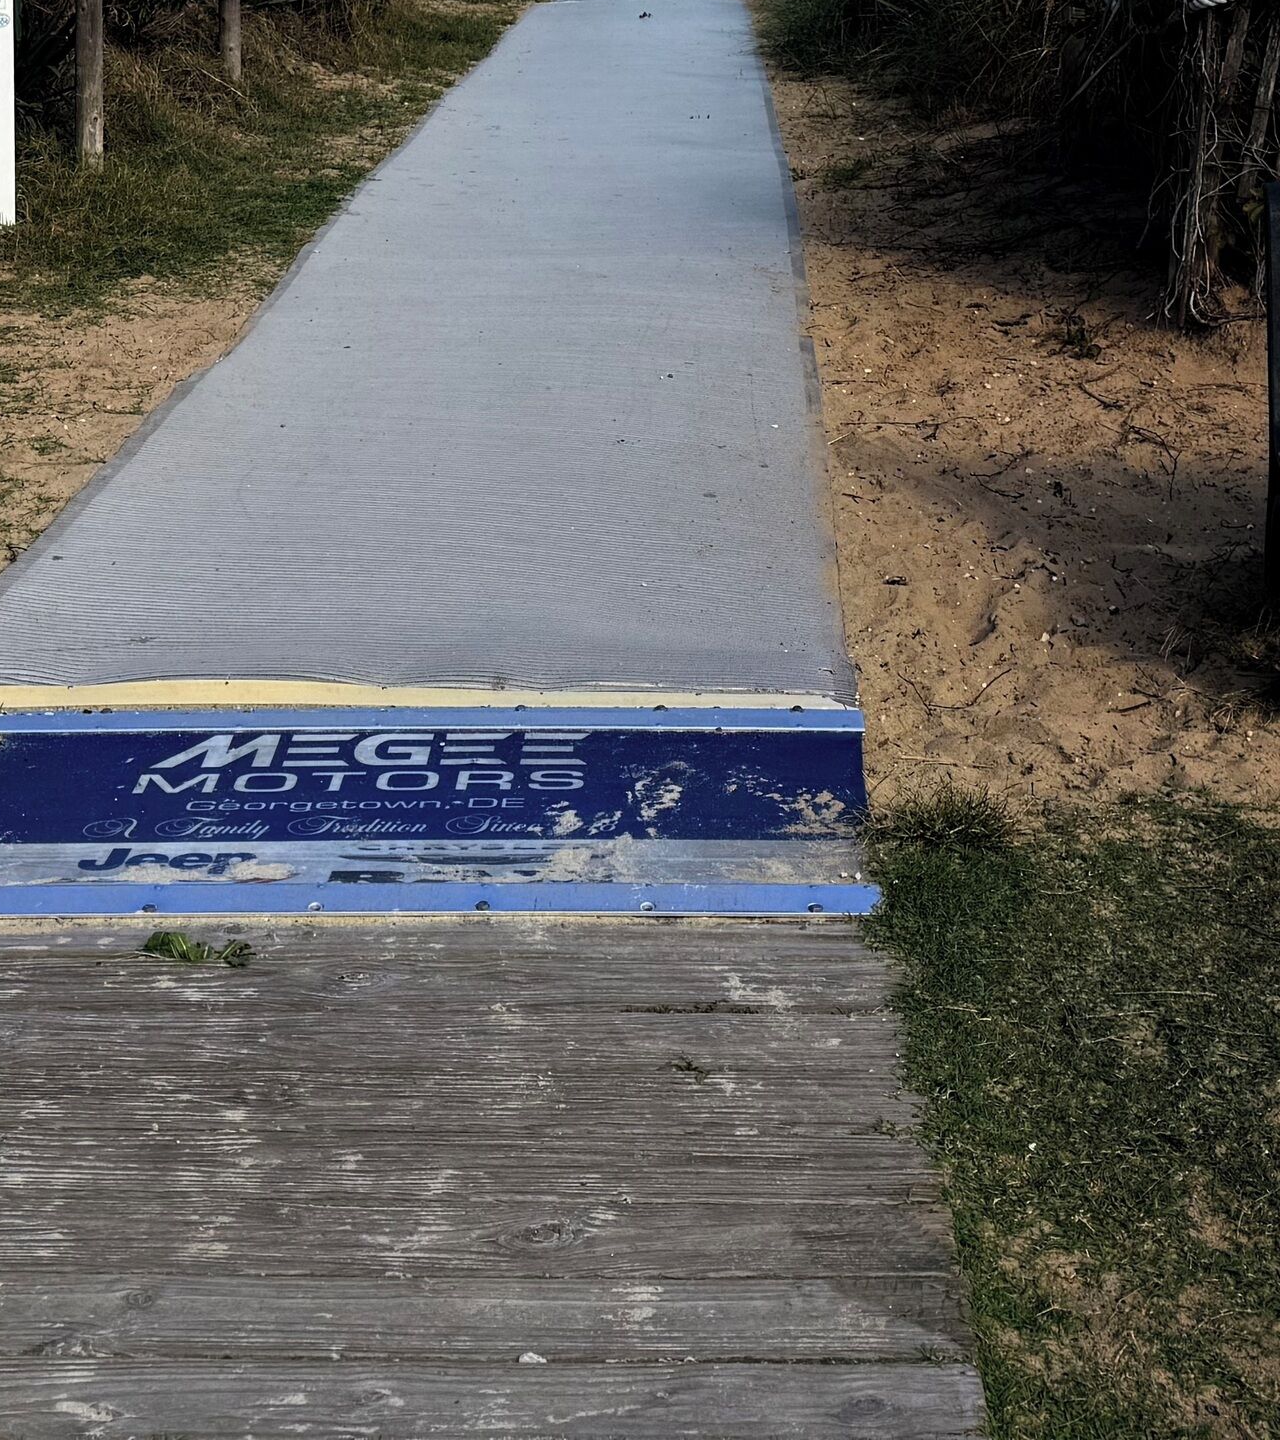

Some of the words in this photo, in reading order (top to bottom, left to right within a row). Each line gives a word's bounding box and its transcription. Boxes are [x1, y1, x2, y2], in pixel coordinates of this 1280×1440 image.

[150, 732, 591, 769] MEGEE
[131, 770, 585, 794] MOTORS
[467, 797, 525, 809] DE
[154, 816, 271, 840] Family
[287, 814, 428, 839] Tradition
[77, 847, 258, 875] Jeep
